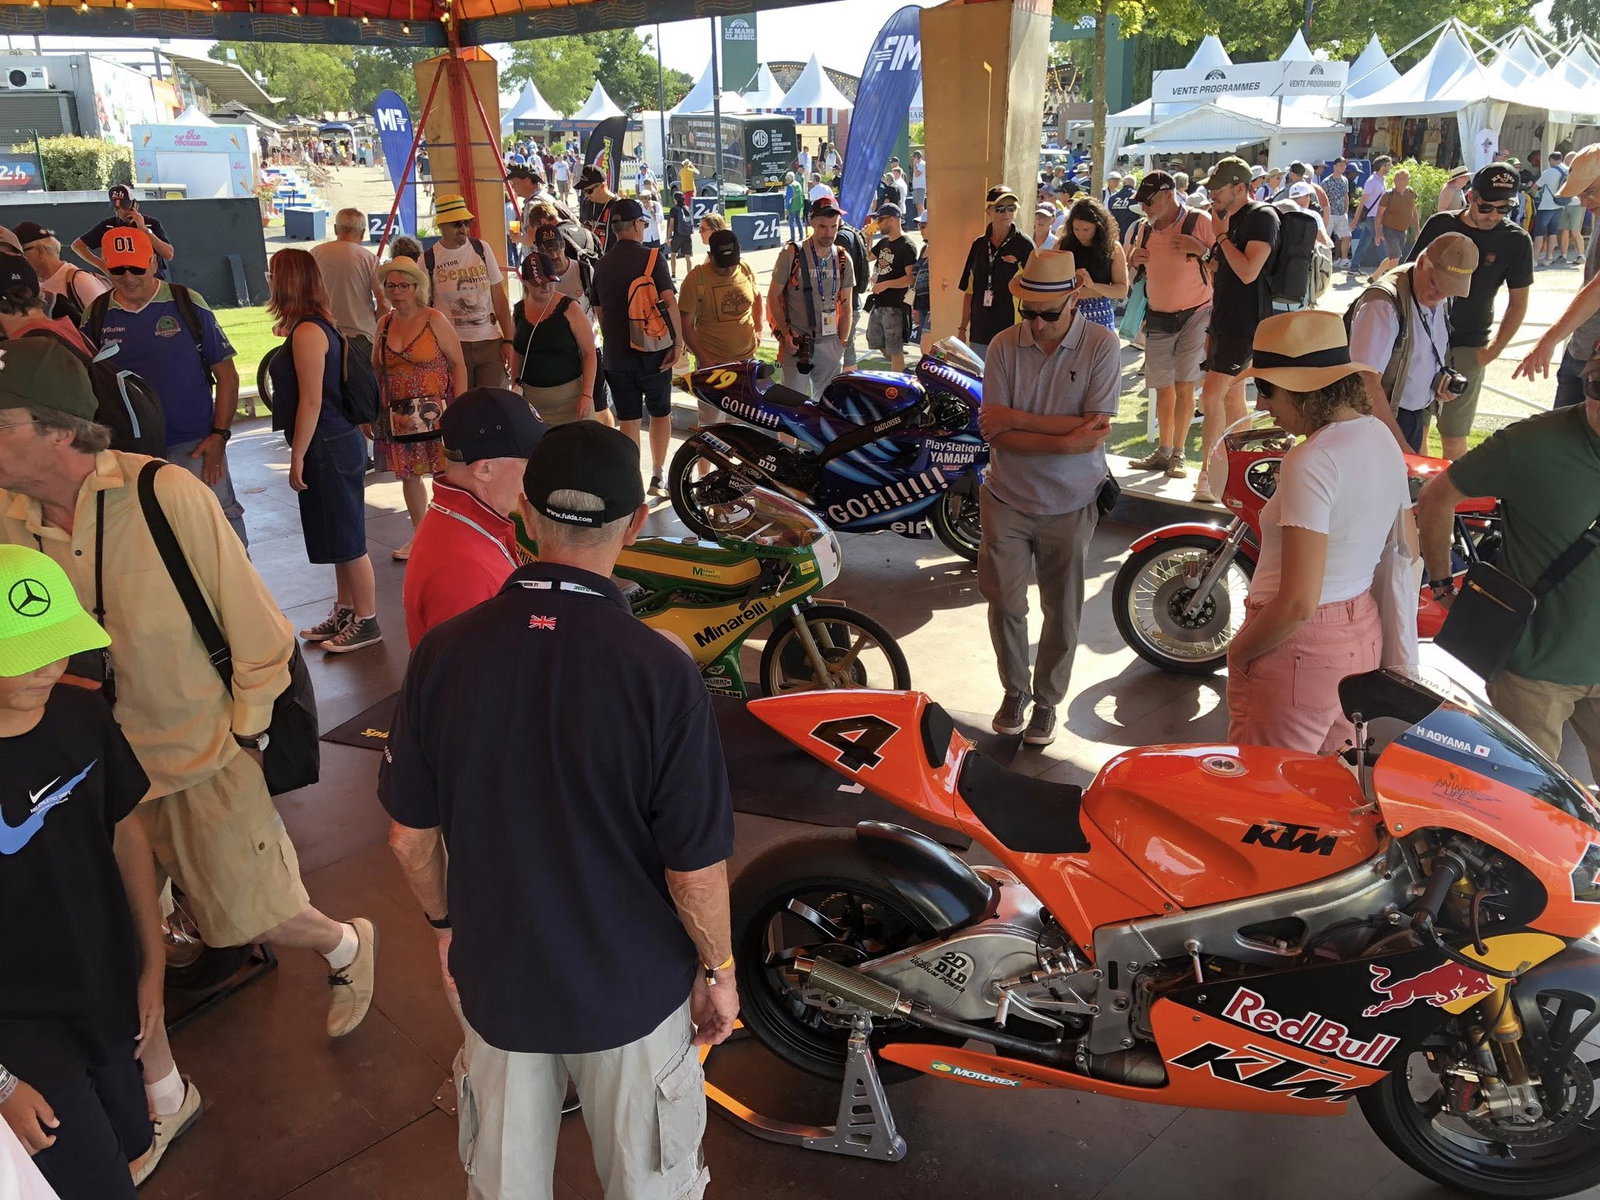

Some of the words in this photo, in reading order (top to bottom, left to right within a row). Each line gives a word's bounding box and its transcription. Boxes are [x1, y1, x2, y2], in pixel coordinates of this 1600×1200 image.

[873, 35, 921, 72] FIM
[1172, 86, 1199, 96] VENTE
[1199, 82, 1261, 94] PROGRAMMES
[1289, 80, 1306, 88] VENTE
[1306, 80, 1342, 88] PROGRAMMES
[753, 131, 767, 147] MG
[753, 218, 780, 240] 24h
[114, 236, 135, 253] 01
[437, 265, 486, 283] Senna
[705, 369, 738, 390] 19
[874, 416, 902, 433] GAULOISES
[925, 439, 980, 454] PlayStation
[930, 451, 975, 464] YAMAHA
[546, 507, 593, 523] www.fulda.com
[890, 520, 927, 535] elf
[693, 601, 768, 648] Minarelli
[809, 714, 902, 773] 4
[1416, 726, 1425, 736] H
[1426, 730, 1471, 752] AOYAMA
[1240, 820, 1338, 857] KTM
[940, 951, 967, 969] 2D
[909, 958, 940, 977] IRIDIUM
[939, 975, 966, 992] POWER
[1222, 986, 1314, 1043] Red
[1306, 1013, 1401, 1067] Bull
[953, 1067, 1020, 1087] MOTOREX
[1167, 1041, 1376, 1104] KTM
